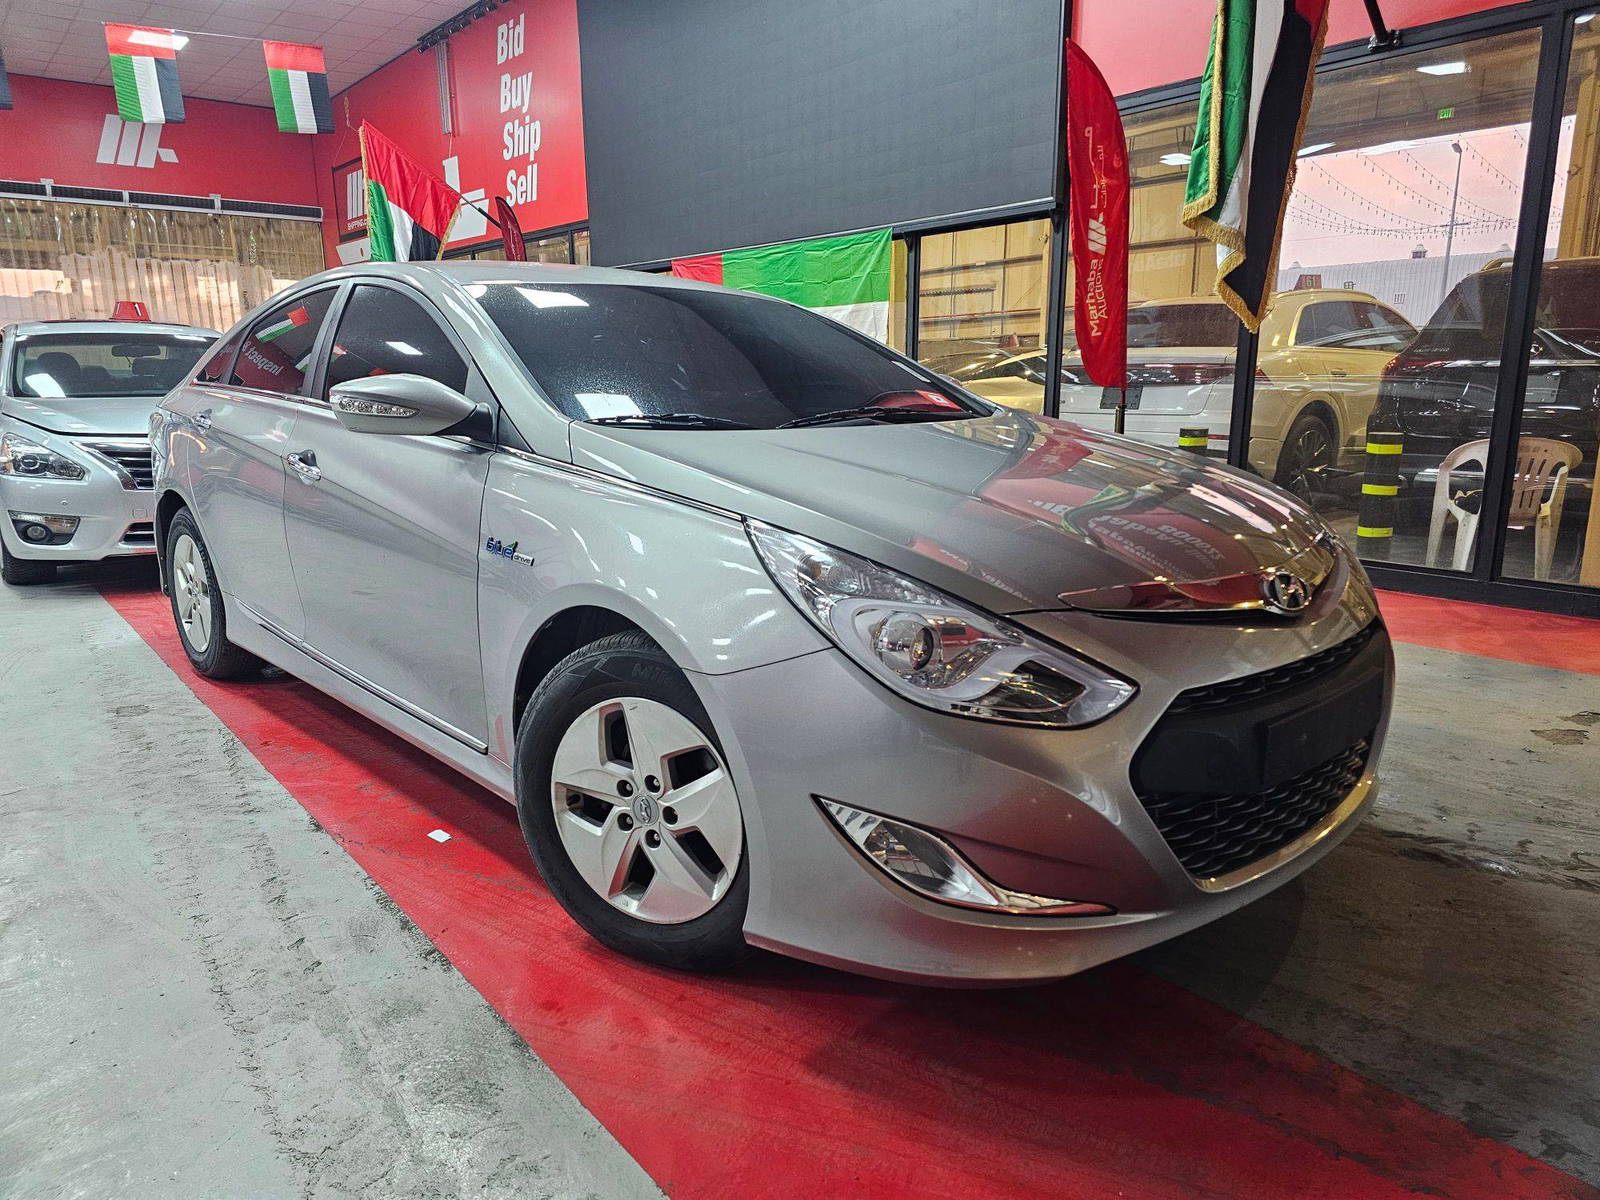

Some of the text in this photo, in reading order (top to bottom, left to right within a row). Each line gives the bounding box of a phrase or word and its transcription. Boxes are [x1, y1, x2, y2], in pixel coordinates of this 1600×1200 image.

[497, 13, 525, 65] Bid
[500, 72, 532, 114] Buy
[503, 115, 541, 162] Ship
[506, 163, 538, 207] Sell
[1086, 259, 1102, 337] Marhaba
[1096, 258, 1108, 319] Auctions
[486, 536, 514, 560] blue
